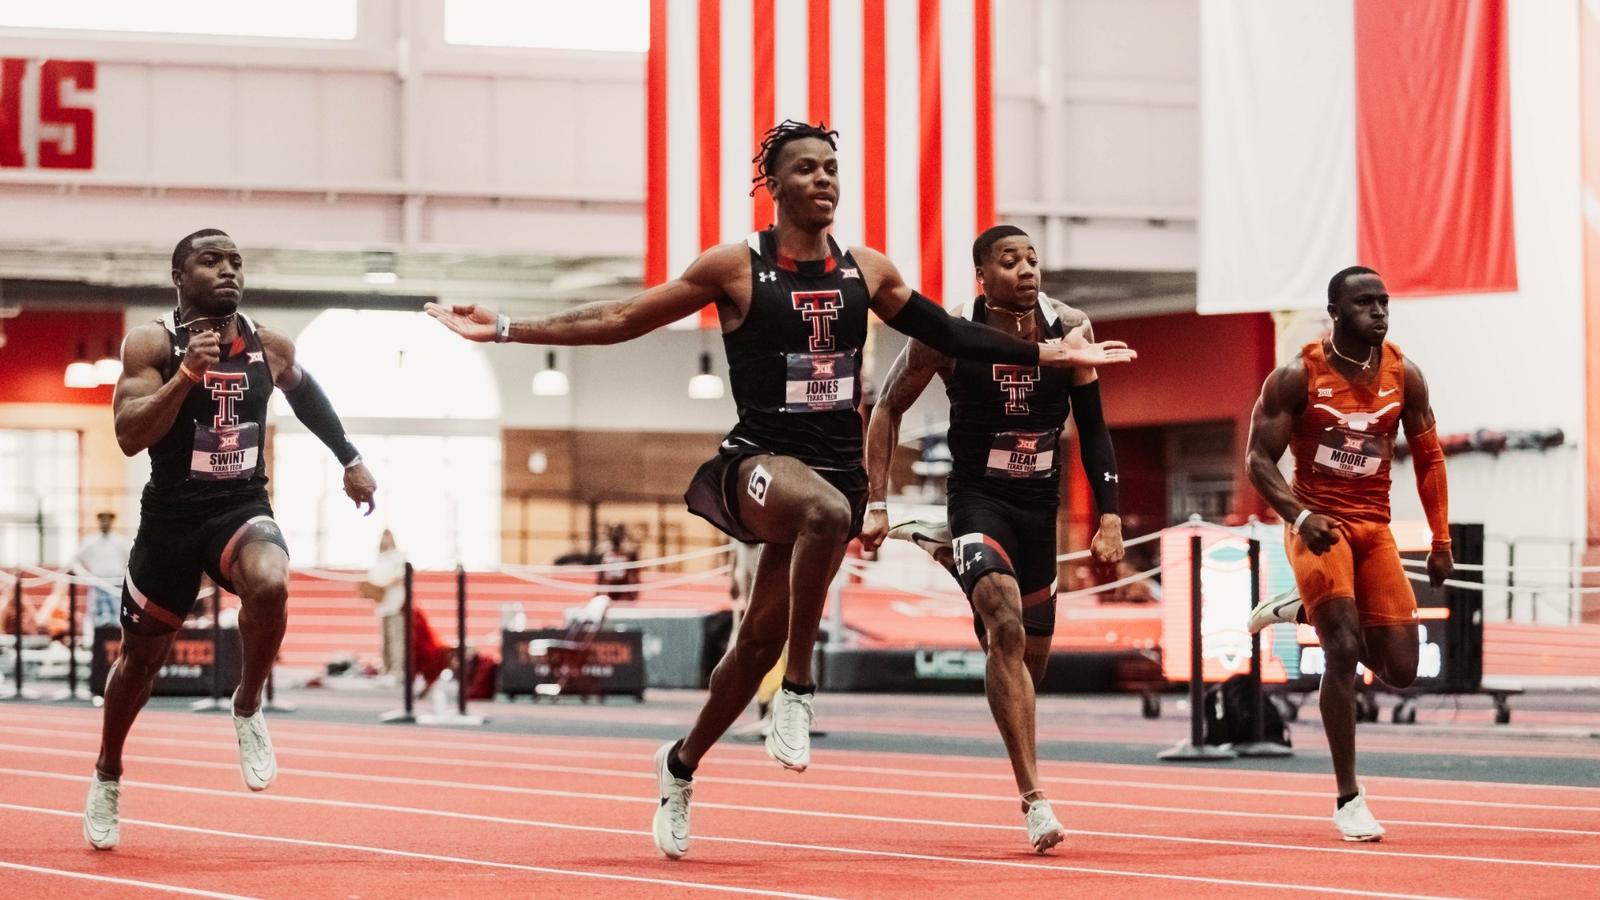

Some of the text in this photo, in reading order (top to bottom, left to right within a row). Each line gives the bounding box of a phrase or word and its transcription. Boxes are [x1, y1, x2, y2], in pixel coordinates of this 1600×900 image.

[806, 380, 839, 395] JONES
[209, 450, 246, 466] SWINT
[1009, 452, 1038, 466] DEAN
[1330, 450, 1368, 467] MOORE
[229, 463, 243, 471] TECH
[1007, 463, 1023, 471] TEXAS
[1339, 463, 1354, 471] TEXAS
